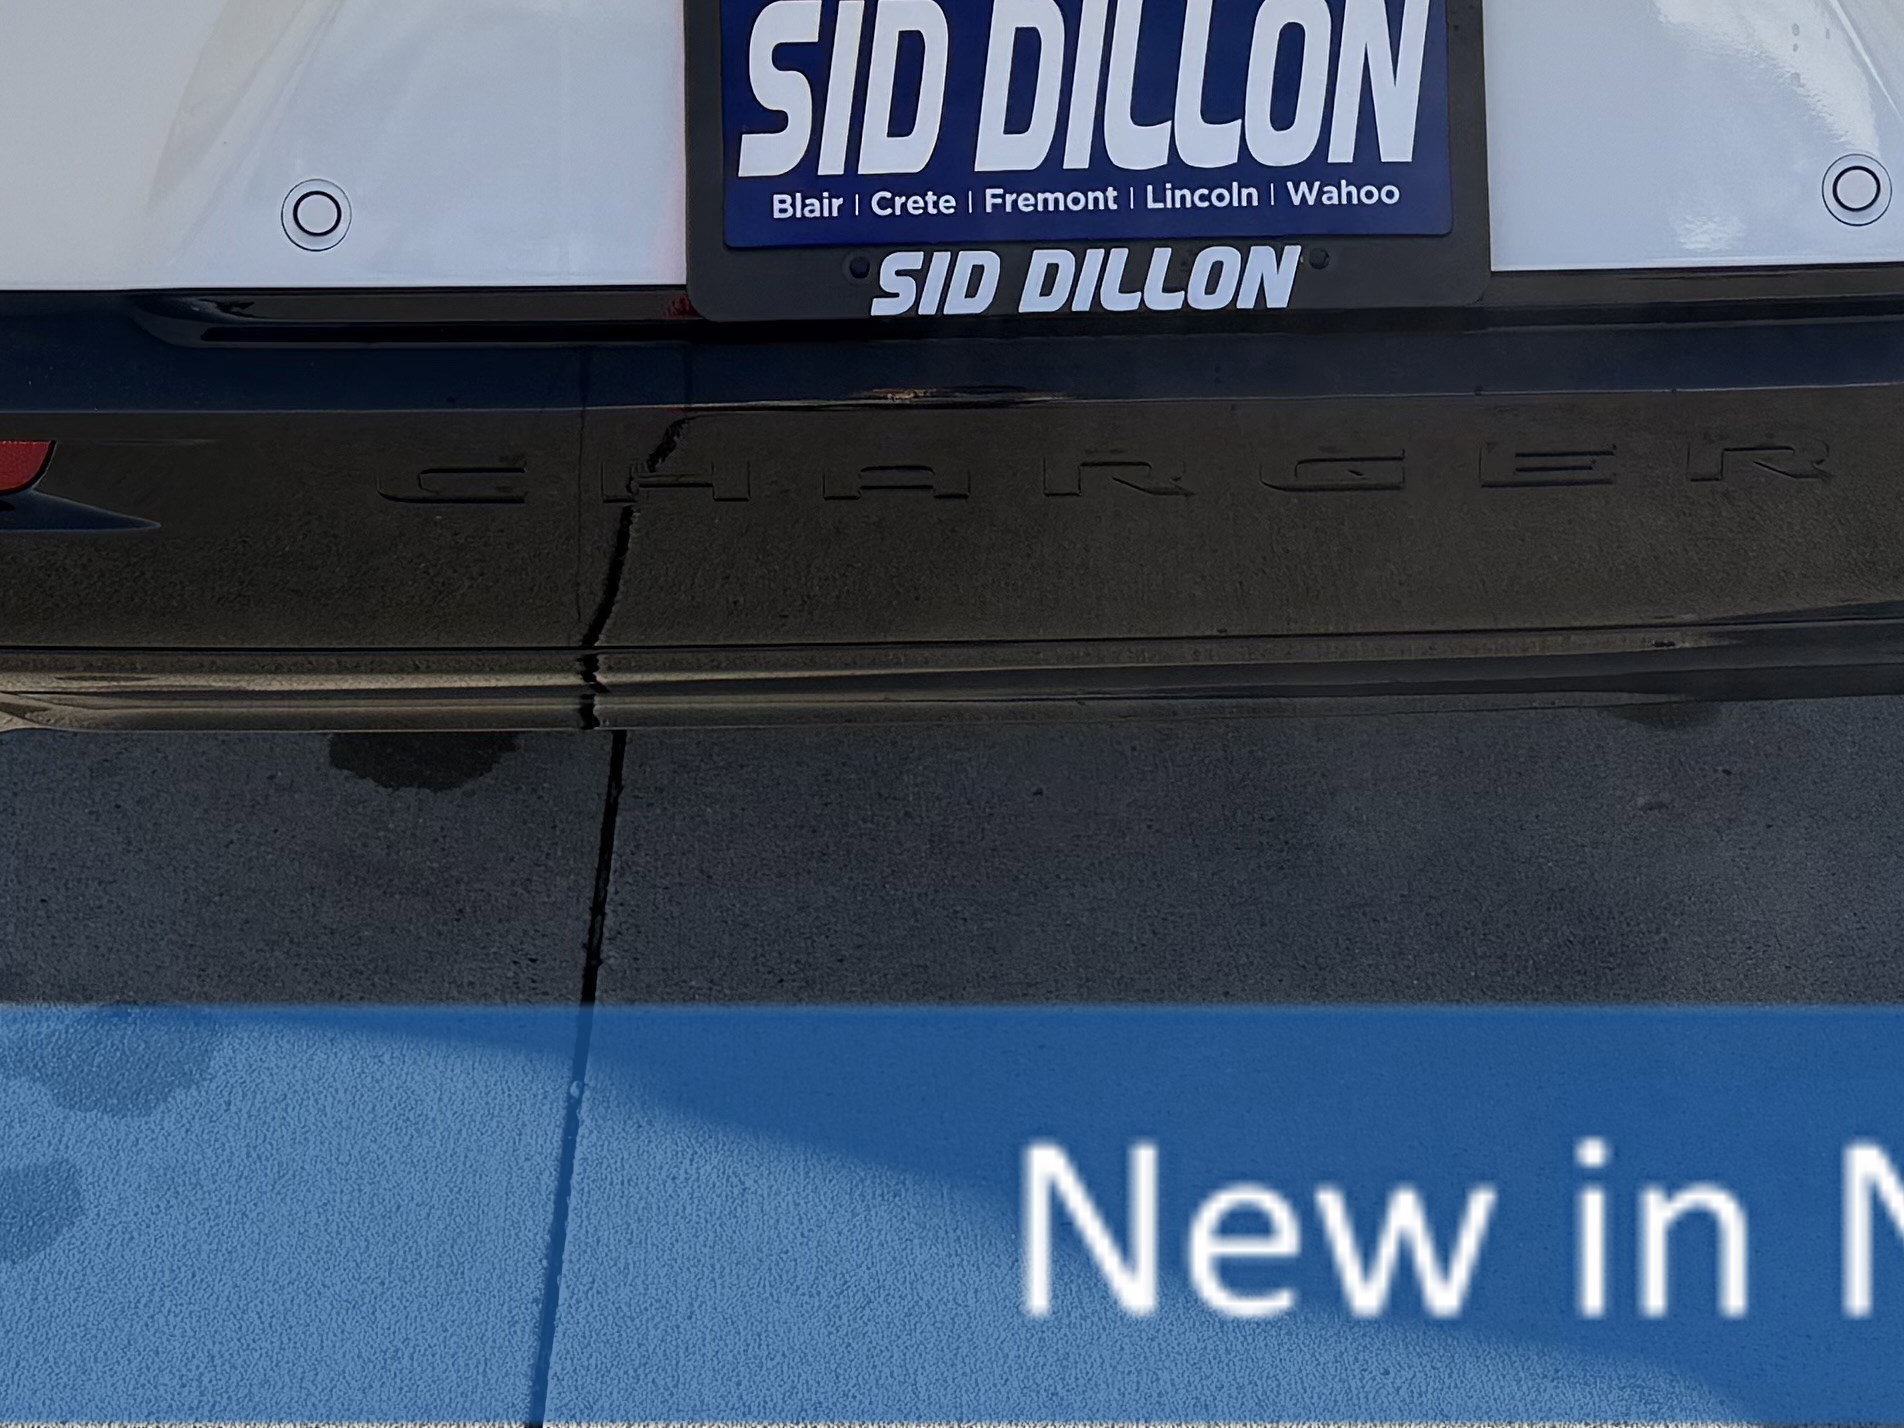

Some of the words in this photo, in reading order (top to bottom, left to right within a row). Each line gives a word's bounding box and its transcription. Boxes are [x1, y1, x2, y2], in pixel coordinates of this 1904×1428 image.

[772, 191, 844, 220] Blair
[871, 190, 957, 217] Crete
[984, 185, 1118, 214] Fremont
[1146, 181, 1259, 210] Lincoln
[1286, 179, 1400, 207] Wahoo
[870, 250, 1001, 317] SID
[1018, 244, 1303, 314] DILLON
[375, 433, 1837, 505] CHARGER
